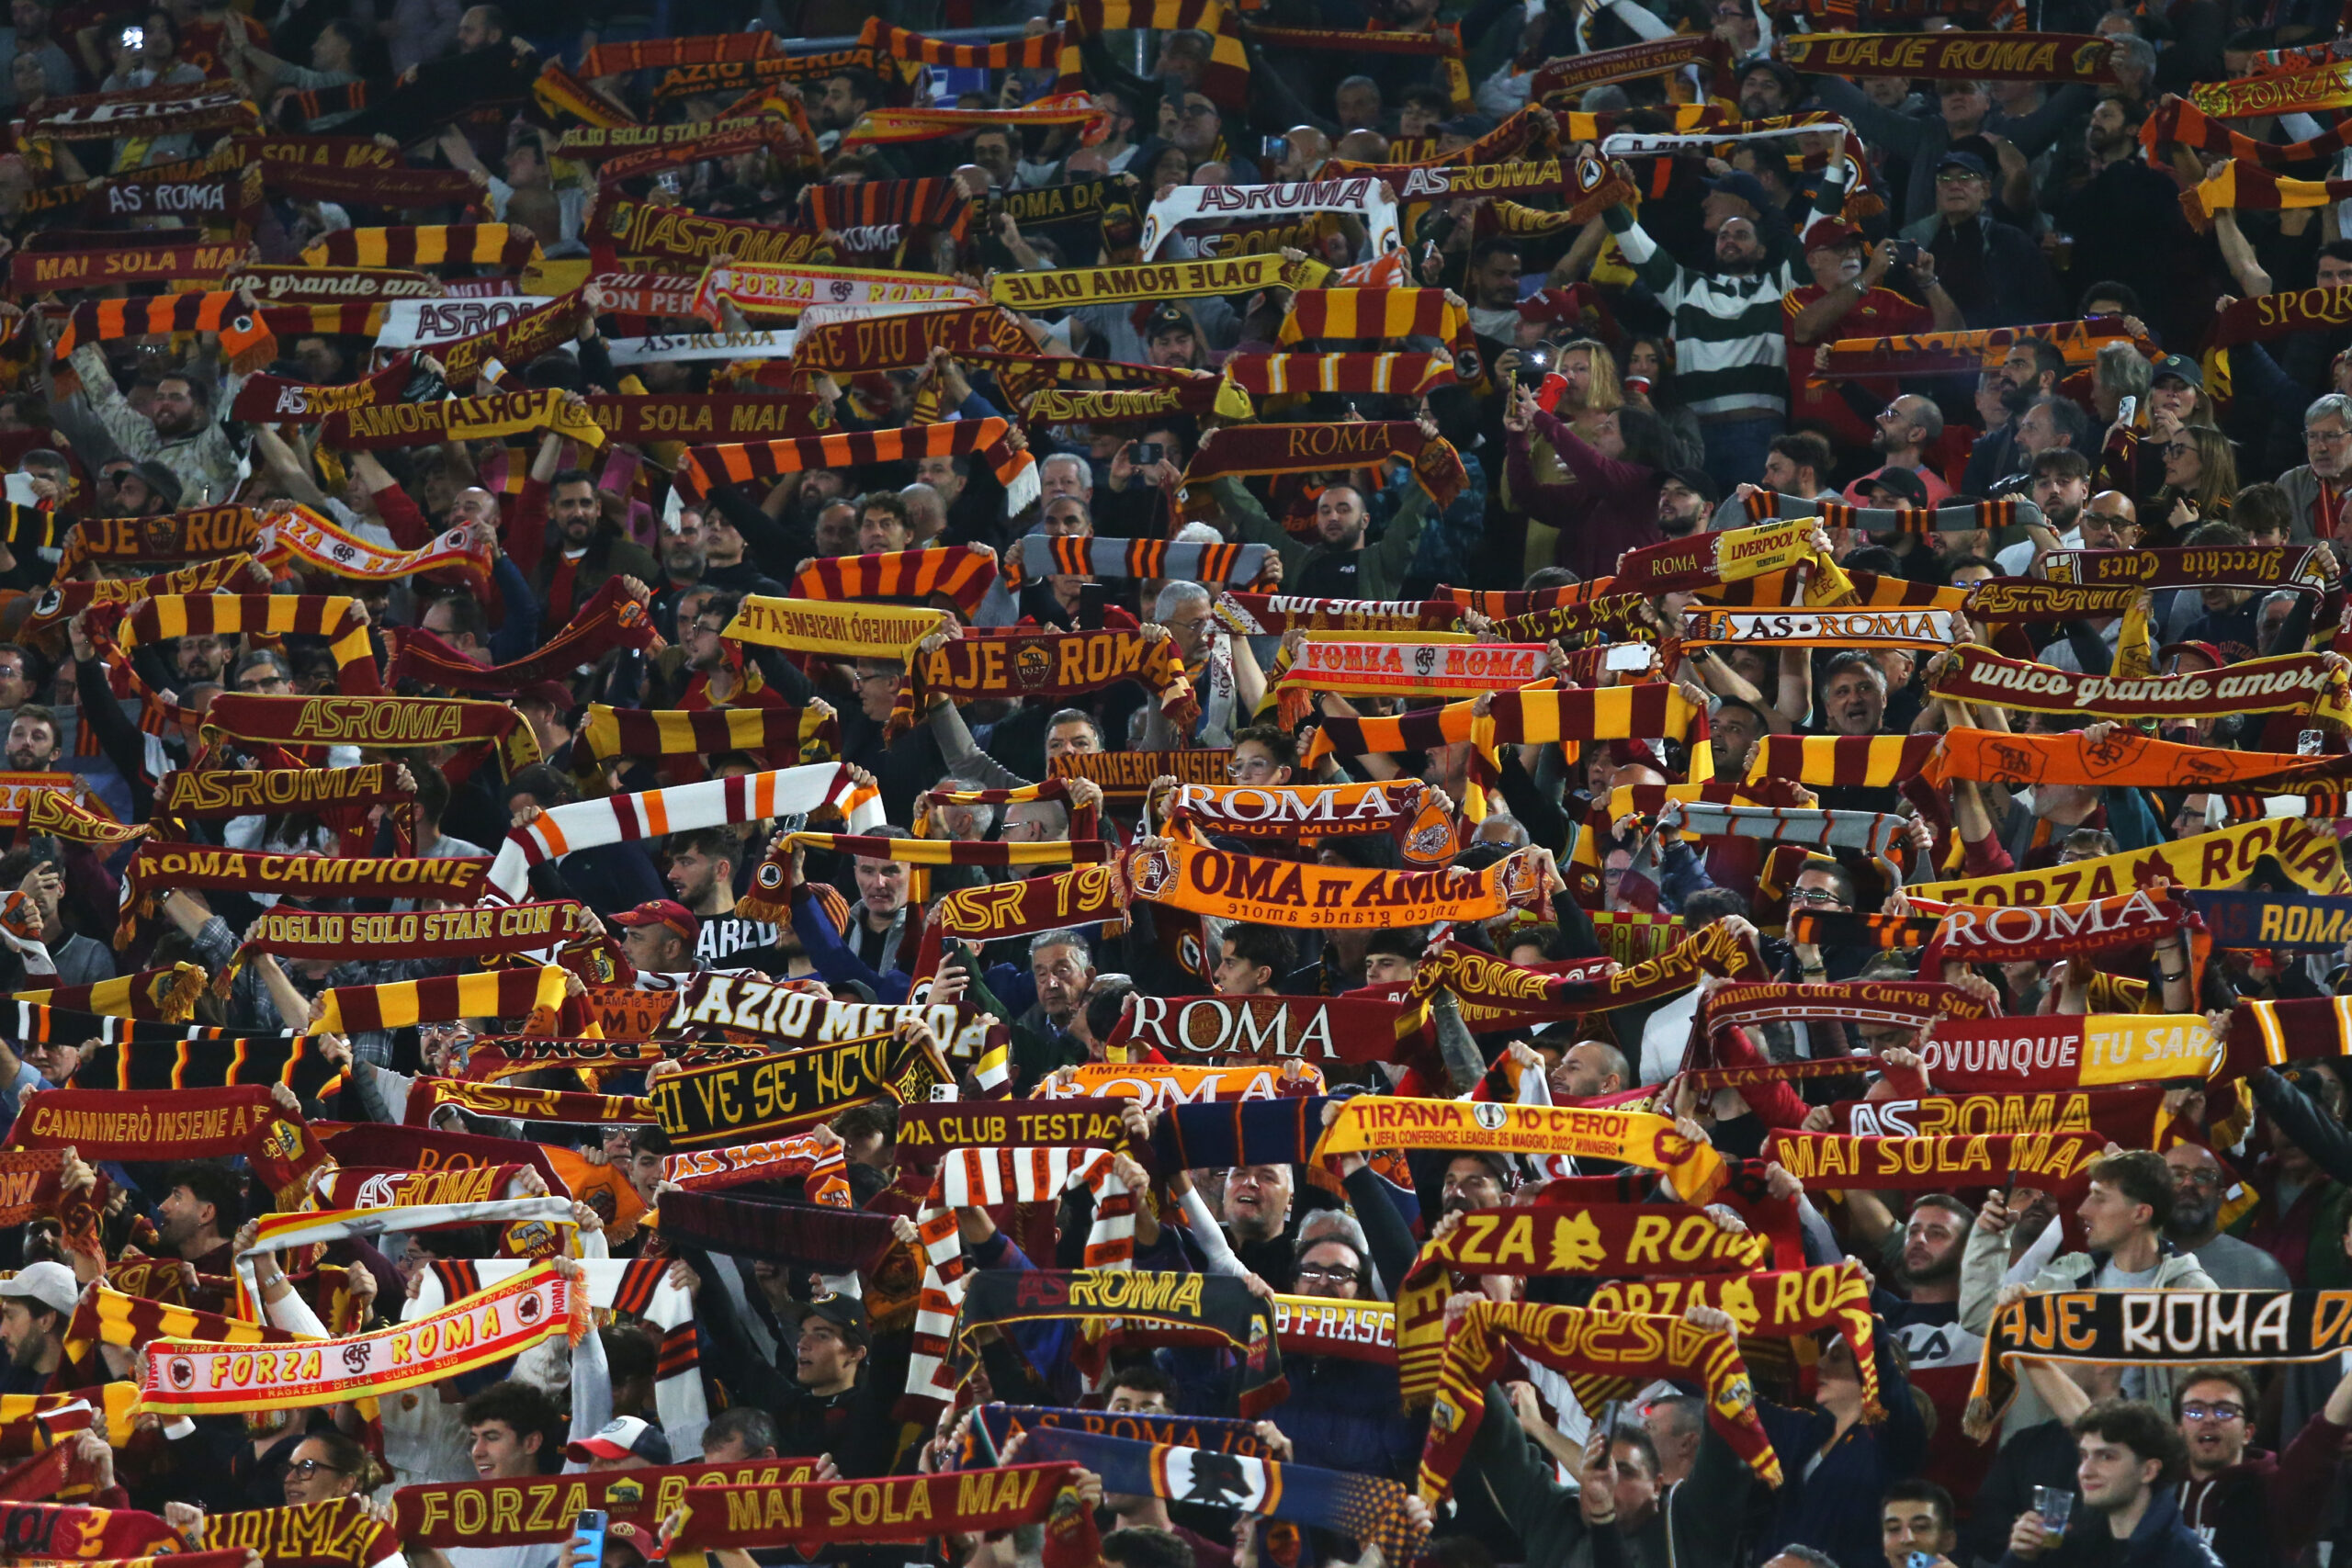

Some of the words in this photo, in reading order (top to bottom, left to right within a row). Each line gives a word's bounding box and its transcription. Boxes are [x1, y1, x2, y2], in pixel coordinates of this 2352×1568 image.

[1563, 71, 1588, 86] THE
[1589, 57, 1650, 81] ULTIMATE
[1653, 49, 1695, 65] STAGE
[1939, 39, 2062, 73] ROMA
[2228, 70, 2350, 115] FORZA
[610, 125, 659, 145] SOLO
[663, 121, 712, 142] STAR
[262, 143, 329, 168] SOLA
[1197, 176, 1371, 211] ASROMA
[1402, 159, 1562, 197] ASROMA
[649, 211, 821, 265] ASROMA
[36, 255, 88, 282] MAI
[105, 252, 175, 275] SOLA
[274, 273, 376, 297] grande
[729, 273, 815, 299] FORZA
[868, 285, 956, 303] ROMA
[2257, 286, 2352, 326] SPQR
[856, 320, 910, 365] DIO
[639, 404, 713, 432] SOLA
[730, 404, 789, 432] MAI
[1287, 423, 1391, 457] ROMA
[1653, 553, 1698, 577] ROMA
[1730, 531, 1794, 561] LIVERPOOL
[1327, 598, 1422, 618] SIAMO
[1747, 616, 1794, 641] AS
[1816, 613, 1941, 641] ROMA
[1057, 631, 1169, 688] ROMA
[1306, 644, 1404, 672] FORZA
[1445, 648, 1535, 678] ROMA
[1969, 660, 2072, 694] unico
[2073, 672, 2211, 707] grande
[293, 697, 461, 738] ASROMA
[170, 763, 383, 810] ASROMA
[1179, 783, 1401, 822] ROMA
[140, 851, 248, 879] ROMA
[259, 855, 482, 889] CAMPIONE
[2201, 816, 2339, 886] ROMA
[351, 914, 422, 944] SOLO
[424, 909, 492, 941] STAR
[499, 904, 553, 936] CON
[942, 880, 1028, 933] ASR
[1942, 890, 2169, 948] ROMA
[1942, 943, 2044, 961] CAPUT
[2058, 925, 2163, 953] MUNDI
[668, 974, 819, 1041] LAZIO
[1860, 983, 1930, 1007] Curva
[1937, 991, 1985, 1021] Sud
[1129, 996, 1341, 1060] ROMA
[1924, 1033, 2080, 1078] OVUNQUE
[2089, 1031, 2134, 1066] TU
[693, 1069, 743, 1128] VE
[753, 1059, 798, 1120] SE
[1046, 1071, 1279, 1111] ROMA
[30, 1104, 153, 1143] CAMMINERÒ
[155, 1107, 229, 1143] INSIEME
[232, 1108, 248, 1136] A
[939, 1114, 1007, 1143] CLUB
[1351, 1101, 1464, 1130] TIRANA
[1518, 1108, 1542, 1131] IO
[1550, 1109, 1630, 1140] C'ERO!
[1850, 1093, 2093, 1138] ASROMA
[673, 1149, 727, 1183] A.S.
[726, 1135, 826, 1170] ROMA
[1374, 1131, 1397, 1145] UEFA
[1398, 1131, 1459, 1145] CONFERENCE
[1461, 1132, 1496, 1146] LEAGUE
[1498, 1134, 1510, 1147] 25
[1511, 1135, 1550, 1149] MAGGIO
[1551, 1136, 1573, 1151] 2022
[1574, 1137, 1618, 1156] WINNERS
[1776, 1136, 1861, 1179] MAI
[1877, 1135, 1993, 1175] SOLA
[356, 1165, 499, 1209] ASROMA
[443, 1300, 481, 1321] ONORE
[484, 1292, 497, 1304] DI
[551, 1280, 566, 1314] ROMA
[1016, 1268, 1203, 1317] ASROMA
[2121, 1292, 2292, 1353] ROMA
[173, 1344, 213, 1354] TIFARE
[231, 1344, 247, 1353] UN
[210, 1348, 322, 1389] FORZA
[390, 1305, 502, 1365] ROMA
[267, 1382, 322, 1398] RAGAZZI
[334, 1375, 373, 1391] DELLA
[383, 1364, 425, 1382] CURVA
[434, 1355, 459, 1370] SUD
[419, 1482, 590, 1536] FORZA
[726, 1487, 804, 1531] MAI
[829, 1479, 933, 1527] SOLA
[956, 1470, 1040, 1517] MAI
